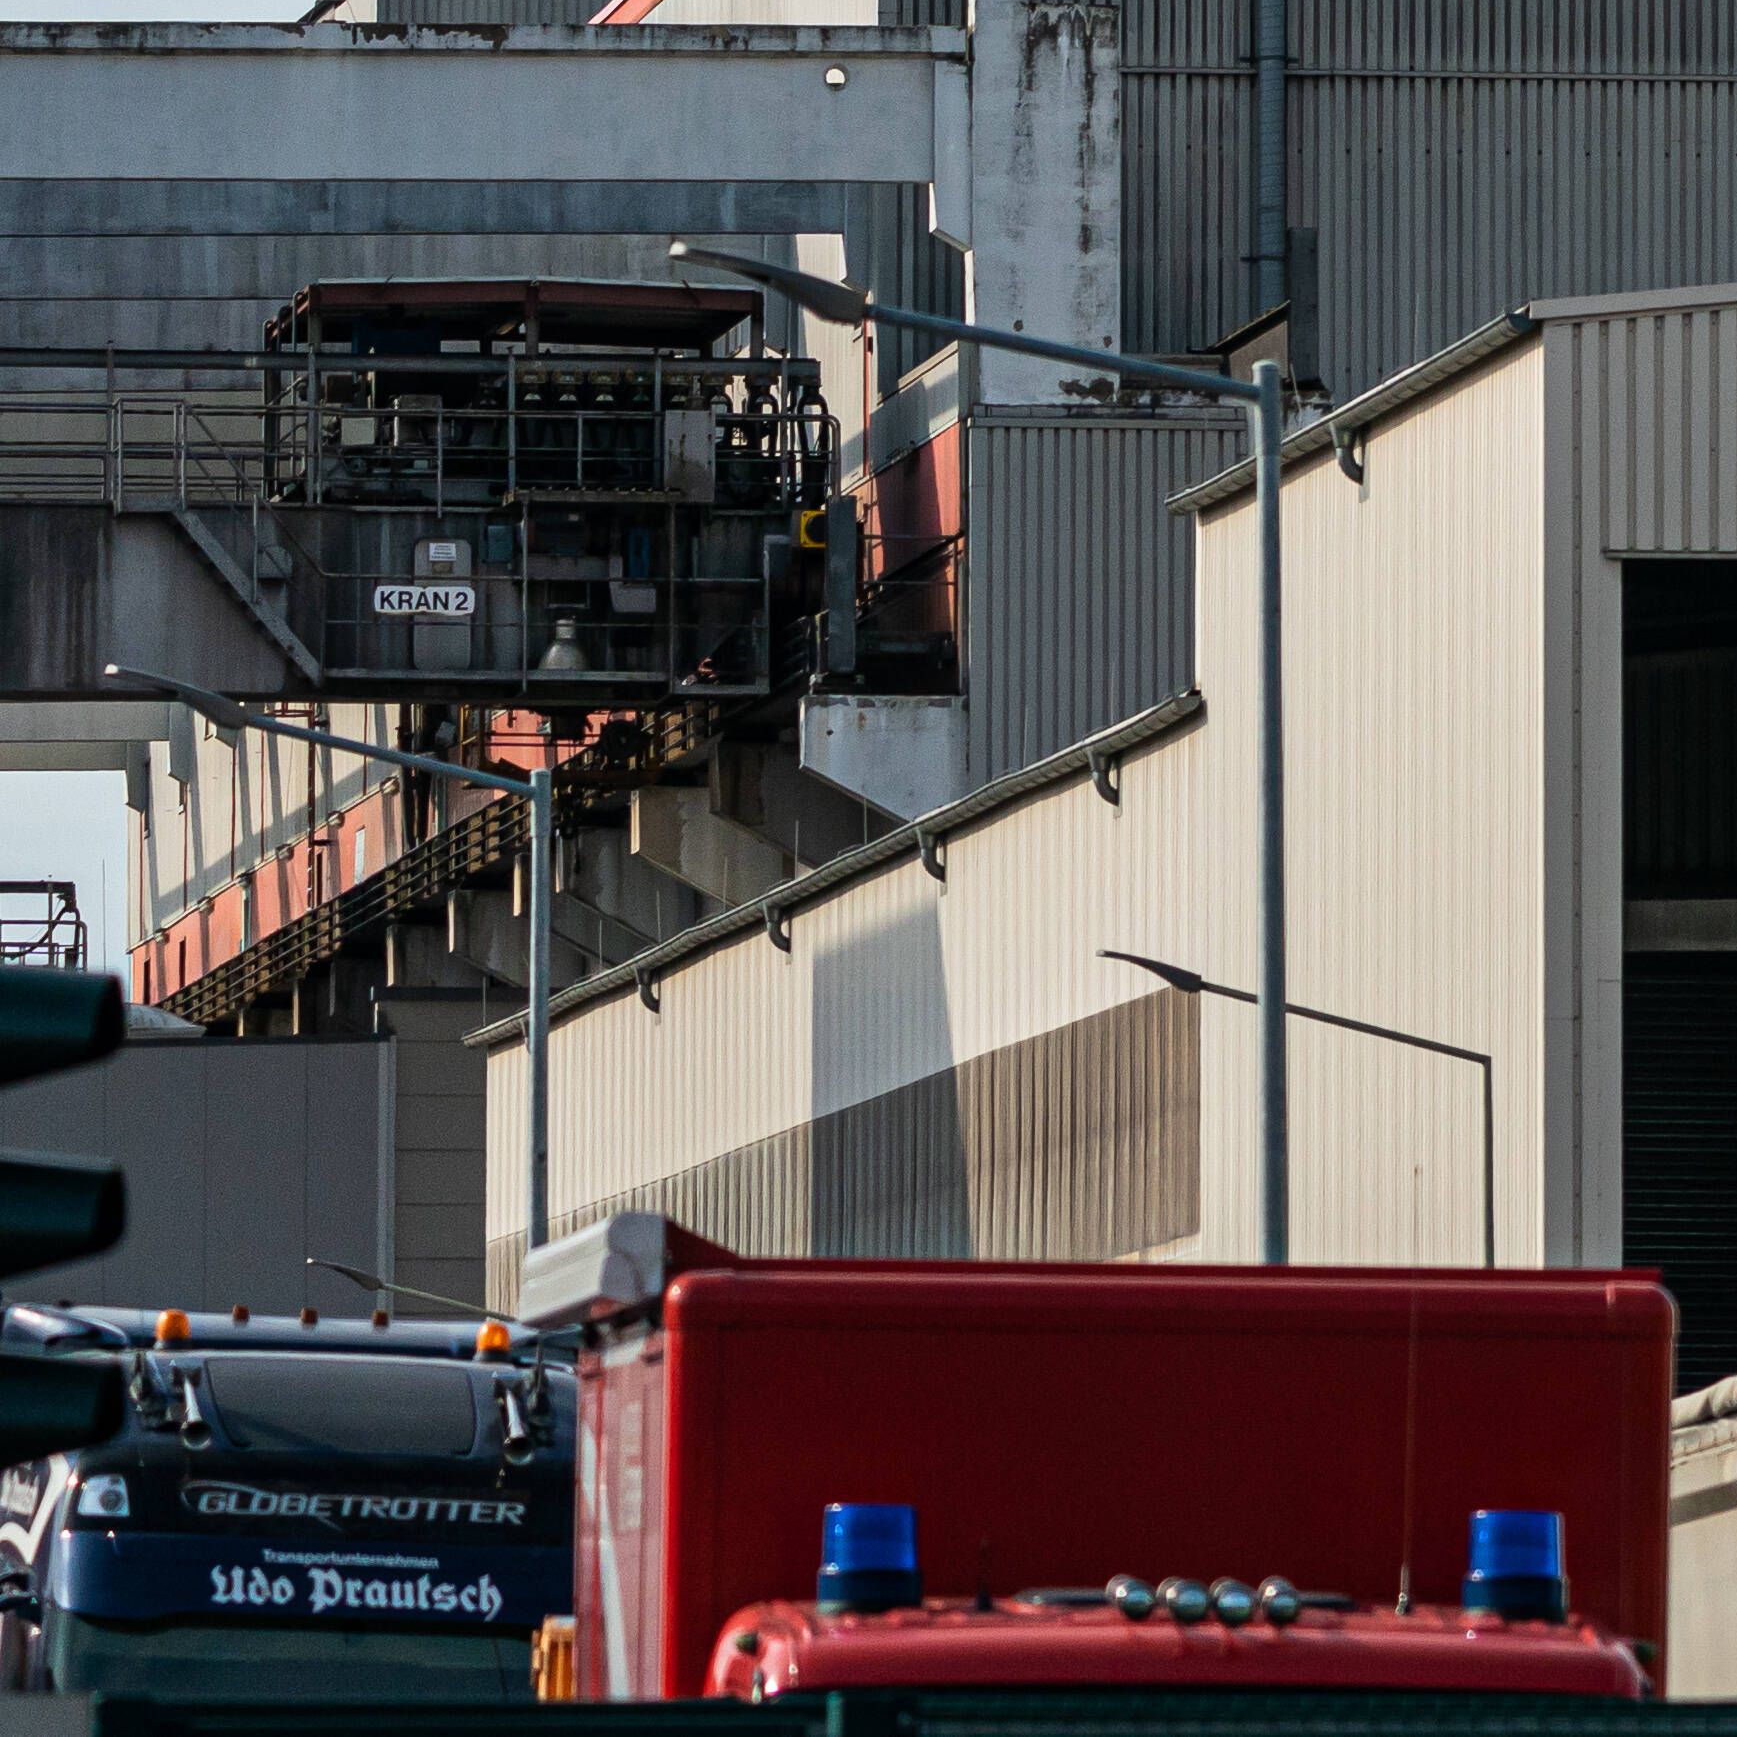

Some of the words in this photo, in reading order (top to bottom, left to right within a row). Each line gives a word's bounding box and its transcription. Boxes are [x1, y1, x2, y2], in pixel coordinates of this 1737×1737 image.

[380, 590, 450, 611] KRAN
[454, 591, 469, 611] 2
[198, 1490, 526, 1526] GLOBETROTTER
[211, 1565, 294, 1605] Udo
